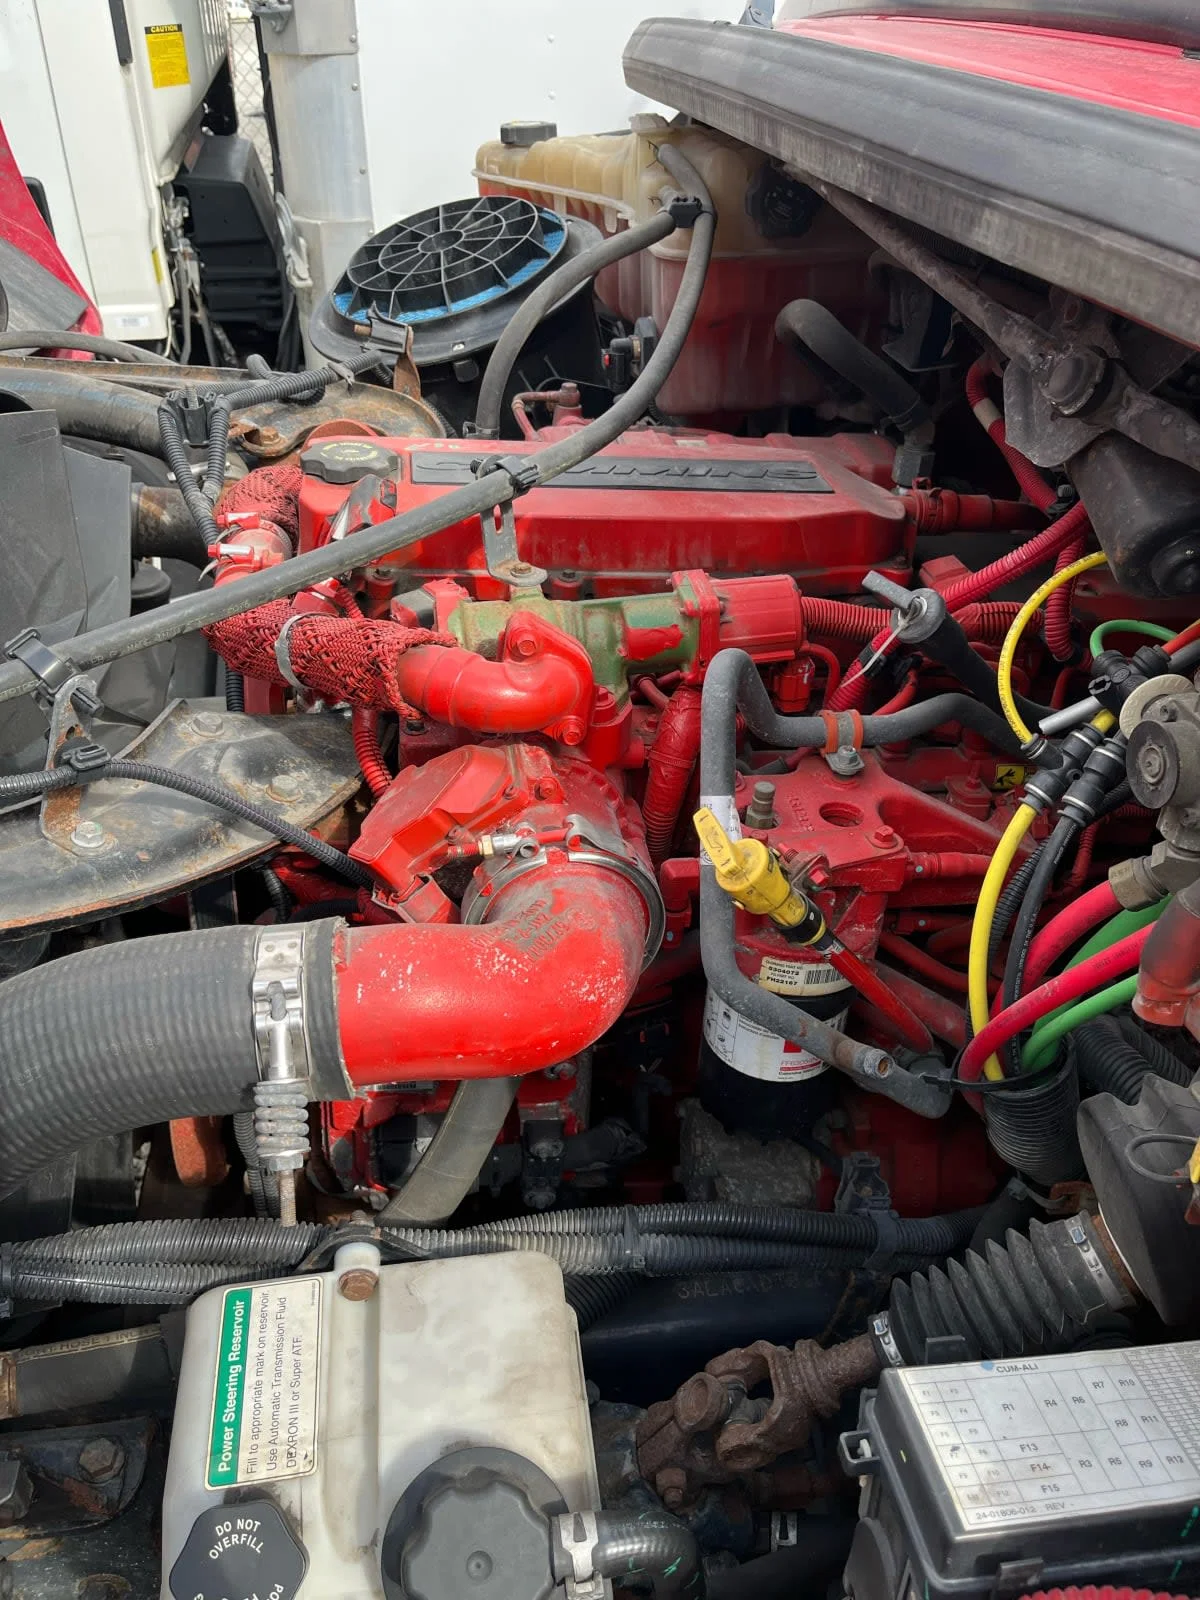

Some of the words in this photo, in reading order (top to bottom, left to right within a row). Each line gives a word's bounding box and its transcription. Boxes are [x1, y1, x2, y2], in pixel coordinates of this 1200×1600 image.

[151, 25, 178, 33] CAUTION
[260, 1291, 270, 1336] reservoir.
[276, 1297, 287, 1320] Fluid
[228, 1299, 245, 1362] Reservoir
[258, 1337, 266, 1348] on
[256, 1349, 265, 1377] mark
[272, 1322, 285, 1388] Transmission
[290, 1359, 303, 1390] Super
[996, 1363, 1038, 1373] CUM-ALI
[222, 1364, 242, 1423] Steering
[1092, 1381, 1105, 1390] R7
[1118, 1378, 1136, 1388] R10
[292, 1391, 300, 1401] or
[1002, 1403, 1015, 1412] R1
[1044, 1399, 1058, 1408] R4
[1072, 1396, 1086, 1404] R6
[251, 1379, 263, 1441] appropriate
[268, 1389, 280, 1446] Automatic
[289, 1403, 299, 1418] III
[1114, 1419, 1129, 1428] R8
[1141, 1415, 1160, 1424] R11
[218, 1425, 234, 1472] Power
[249, 1443, 258, 1456] to
[286, 1419, 298, 1468] DEXRON
[1020, 1443, 1039, 1452] F13
[246, 1455, 258, 1475] Fill
[266, 1449, 278, 1472] Use
[1078, 1460, 1092, 1468] R3
[1108, 1457, 1122, 1466] R5
[1138, 1460, 1153, 1468] R9
[1166, 1456, 1185, 1464] R12
[1040, 1484, 1060, 1494] F15
[1045, 1502, 1065, 1511] REV
[215, 1521, 232, 1537] DO
[236, 1518, 261, 1532] NOT
[208, 1533, 264, 1560] OVERFILL
